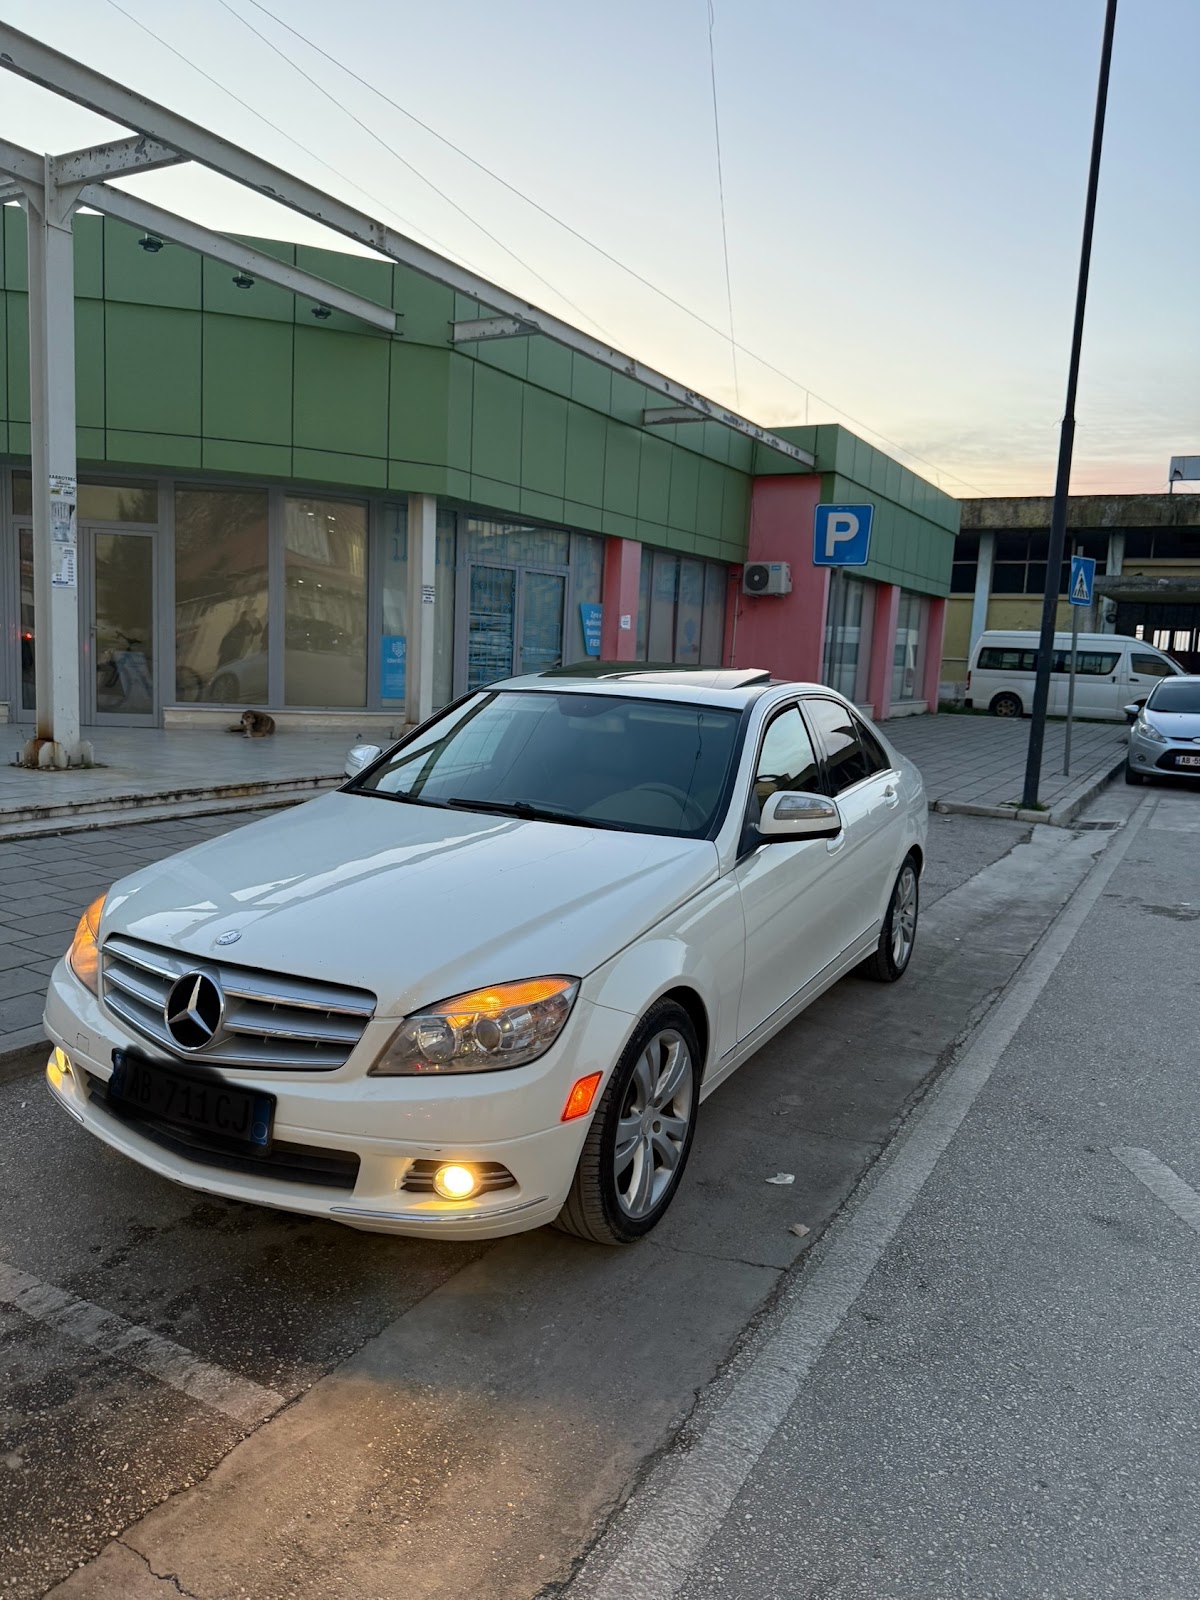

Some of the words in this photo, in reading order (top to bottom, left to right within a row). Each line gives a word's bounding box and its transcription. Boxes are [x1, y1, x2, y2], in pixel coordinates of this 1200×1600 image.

[825, 512, 859, 556] P
[1181, 756, 1191, 764] AB
[129, 1066, 152, 1104] AB
[161, 1078, 209, 1125] 711
